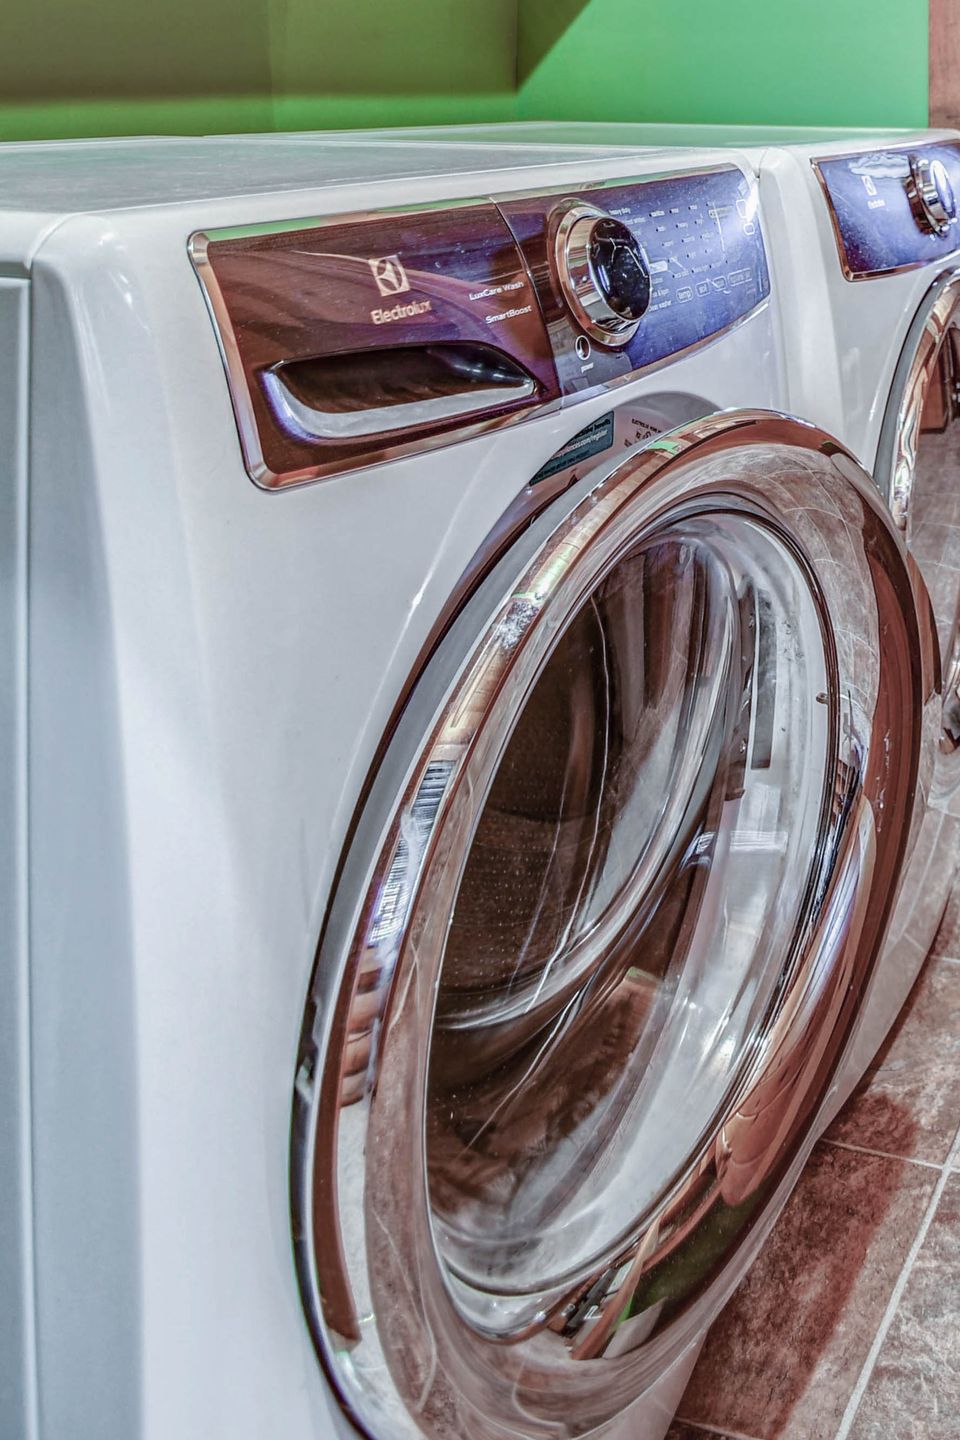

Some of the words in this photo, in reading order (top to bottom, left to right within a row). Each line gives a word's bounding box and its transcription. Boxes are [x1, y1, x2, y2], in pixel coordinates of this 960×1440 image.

[469, 287, 502, 301] LuxCare
[503, 281, 525, 292] Wash
[370, 299, 432, 325] Electrolux
[485, 305, 532, 324] SmartBoost
